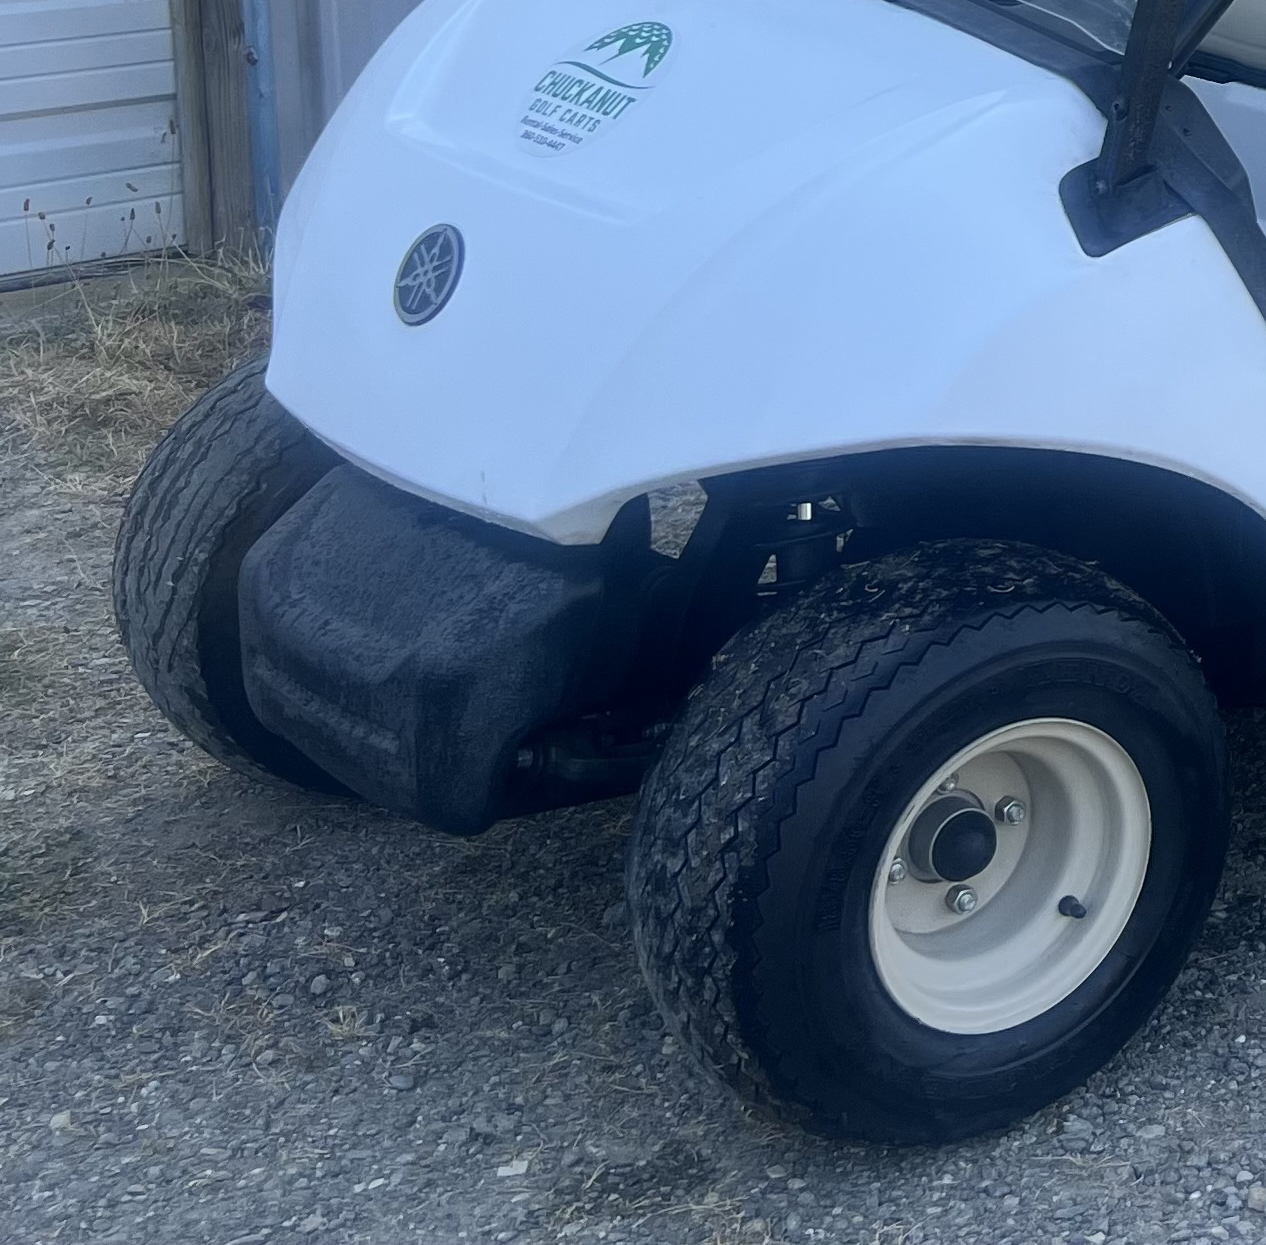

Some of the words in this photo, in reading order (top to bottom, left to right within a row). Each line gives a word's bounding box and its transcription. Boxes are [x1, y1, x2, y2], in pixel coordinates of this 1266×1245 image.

[528, 98, 562, 116] GOLF
[558, 108, 602, 133] CARTS
[533, 70, 637, 120] CHUCKANUT
